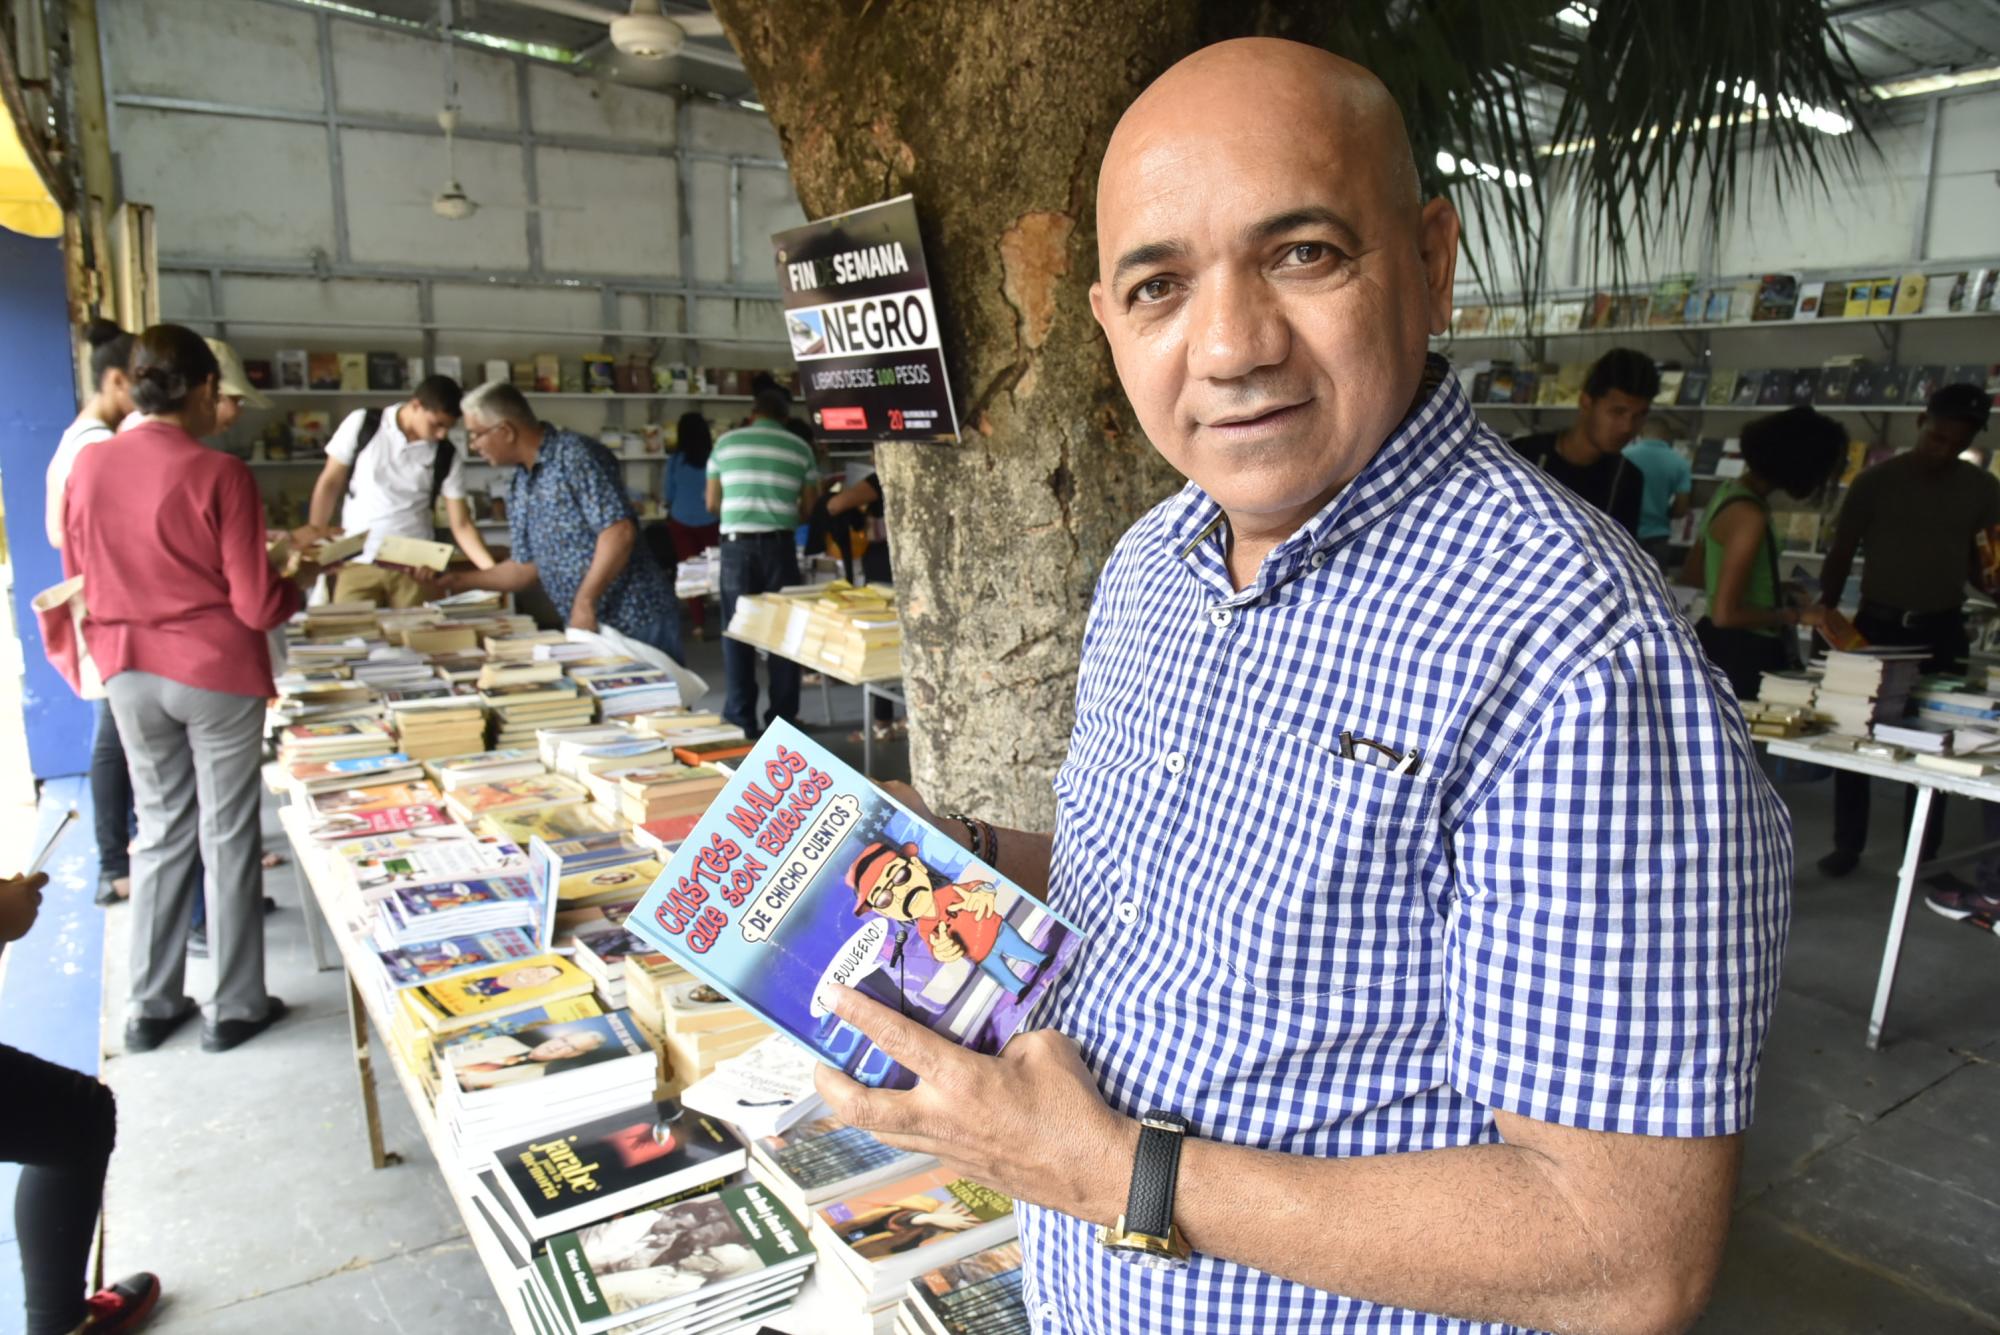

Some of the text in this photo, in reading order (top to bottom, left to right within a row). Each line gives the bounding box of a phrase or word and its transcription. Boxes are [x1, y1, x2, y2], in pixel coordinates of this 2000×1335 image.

[788, 260, 817, 292] FIN
[832, 241, 909, 284] SEMANA
[821, 295, 928, 353] NEGRO
[811, 363, 931, 391] LIBROS DESDE 100 PESOS
[726, 744, 808, 838] MALOS
[720, 853, 768, 908] SON
[748, 805, 850, 933] DE CHICHO CUENTOS
[833, 922, 884, 985] BUUUEENO!
